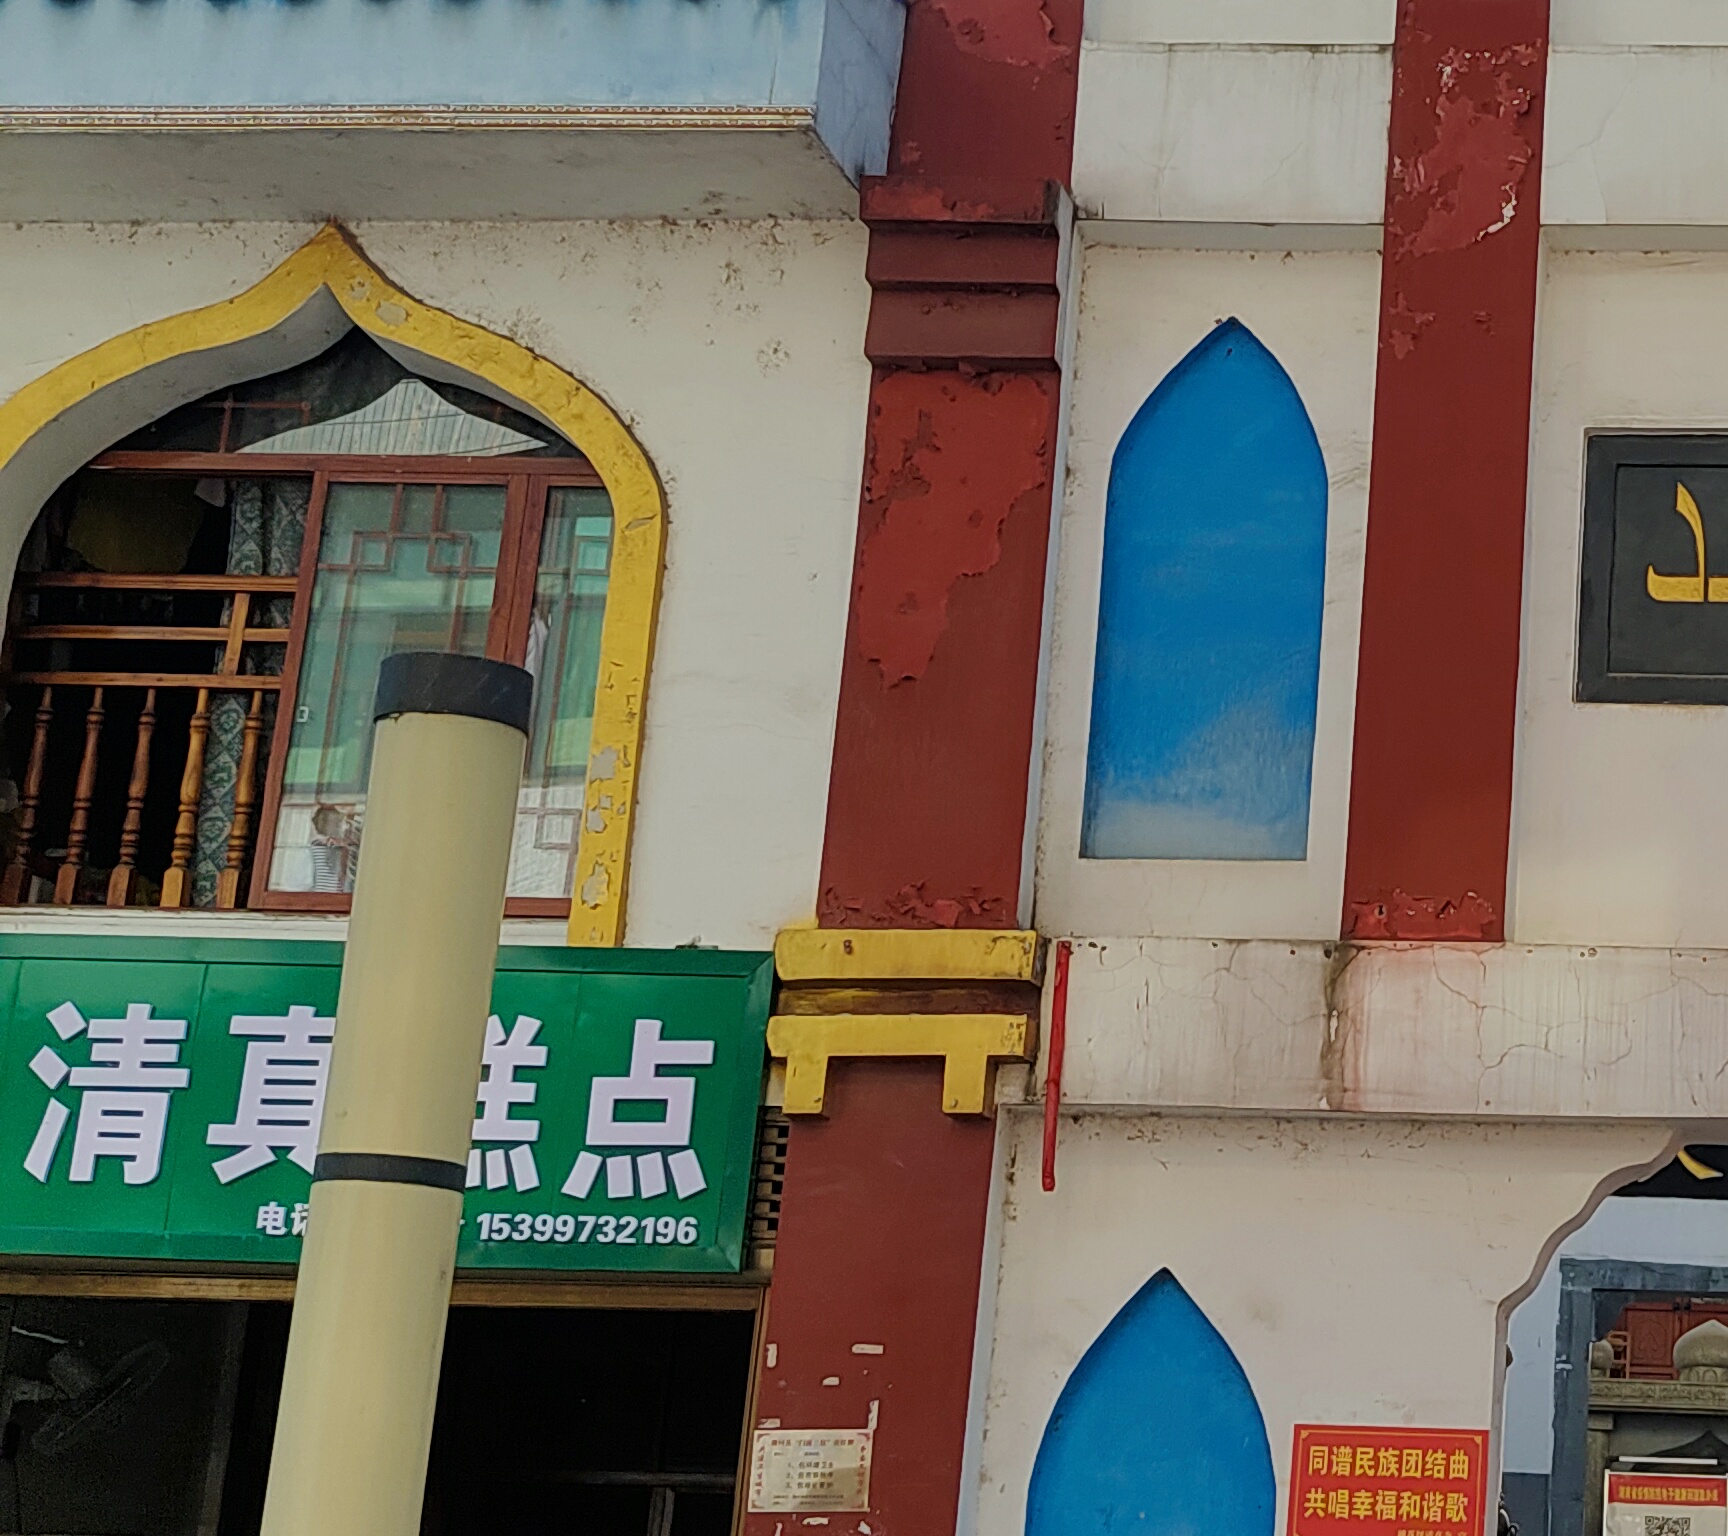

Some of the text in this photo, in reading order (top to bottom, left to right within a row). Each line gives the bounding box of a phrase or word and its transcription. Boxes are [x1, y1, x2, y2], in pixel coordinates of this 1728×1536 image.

[476, 1213, 698, 1244] 15399732196
[1307, 1445, 1470, 1481] 同谱民族团结曲
[1303, 1487, 1469, 1523] 共唱幸福和谐歌
